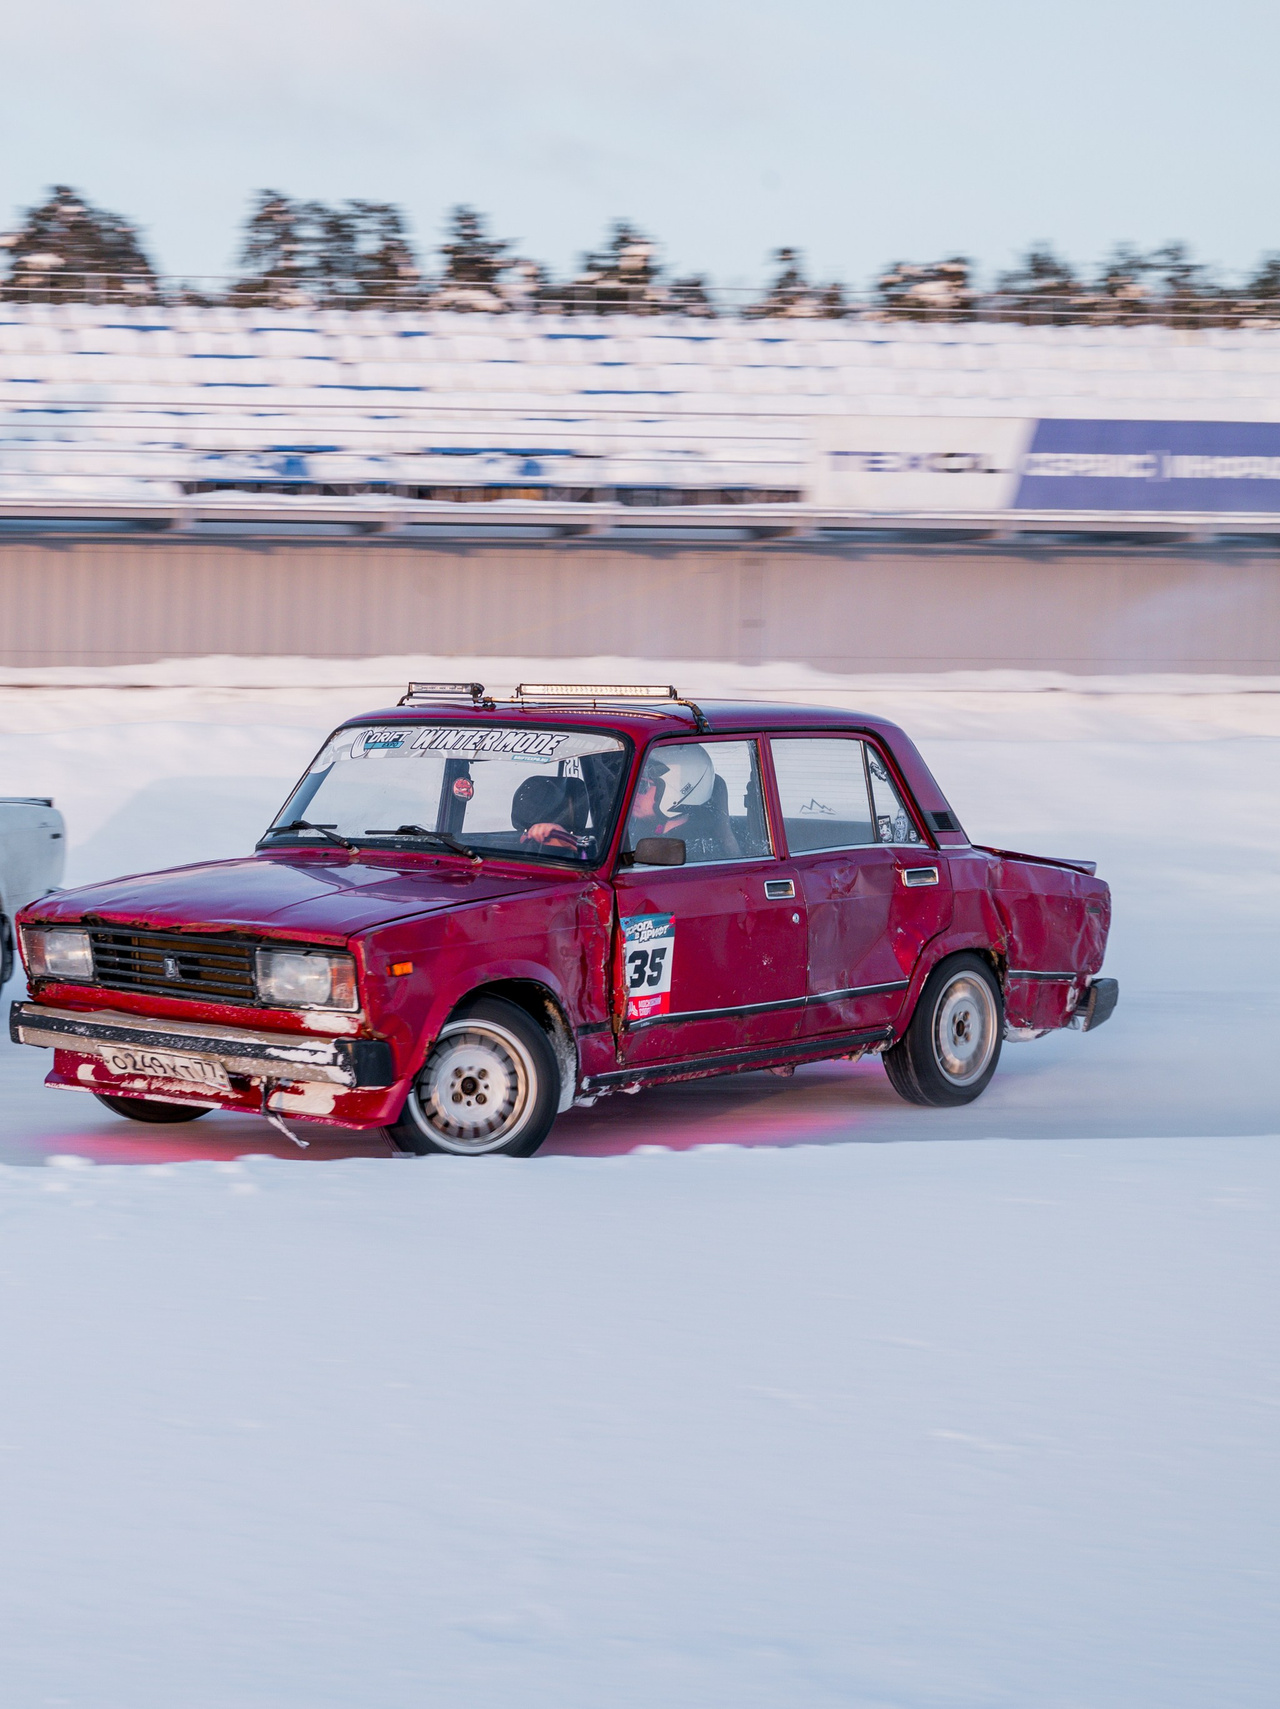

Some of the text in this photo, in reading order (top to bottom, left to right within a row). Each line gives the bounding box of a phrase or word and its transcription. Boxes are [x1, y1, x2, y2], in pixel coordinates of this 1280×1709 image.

[368, 729, 570, 756] DRIFT WINTER MODE
[639, 924, 670, 943] ДРИФТ
[627, 947, 667, 988] 35
